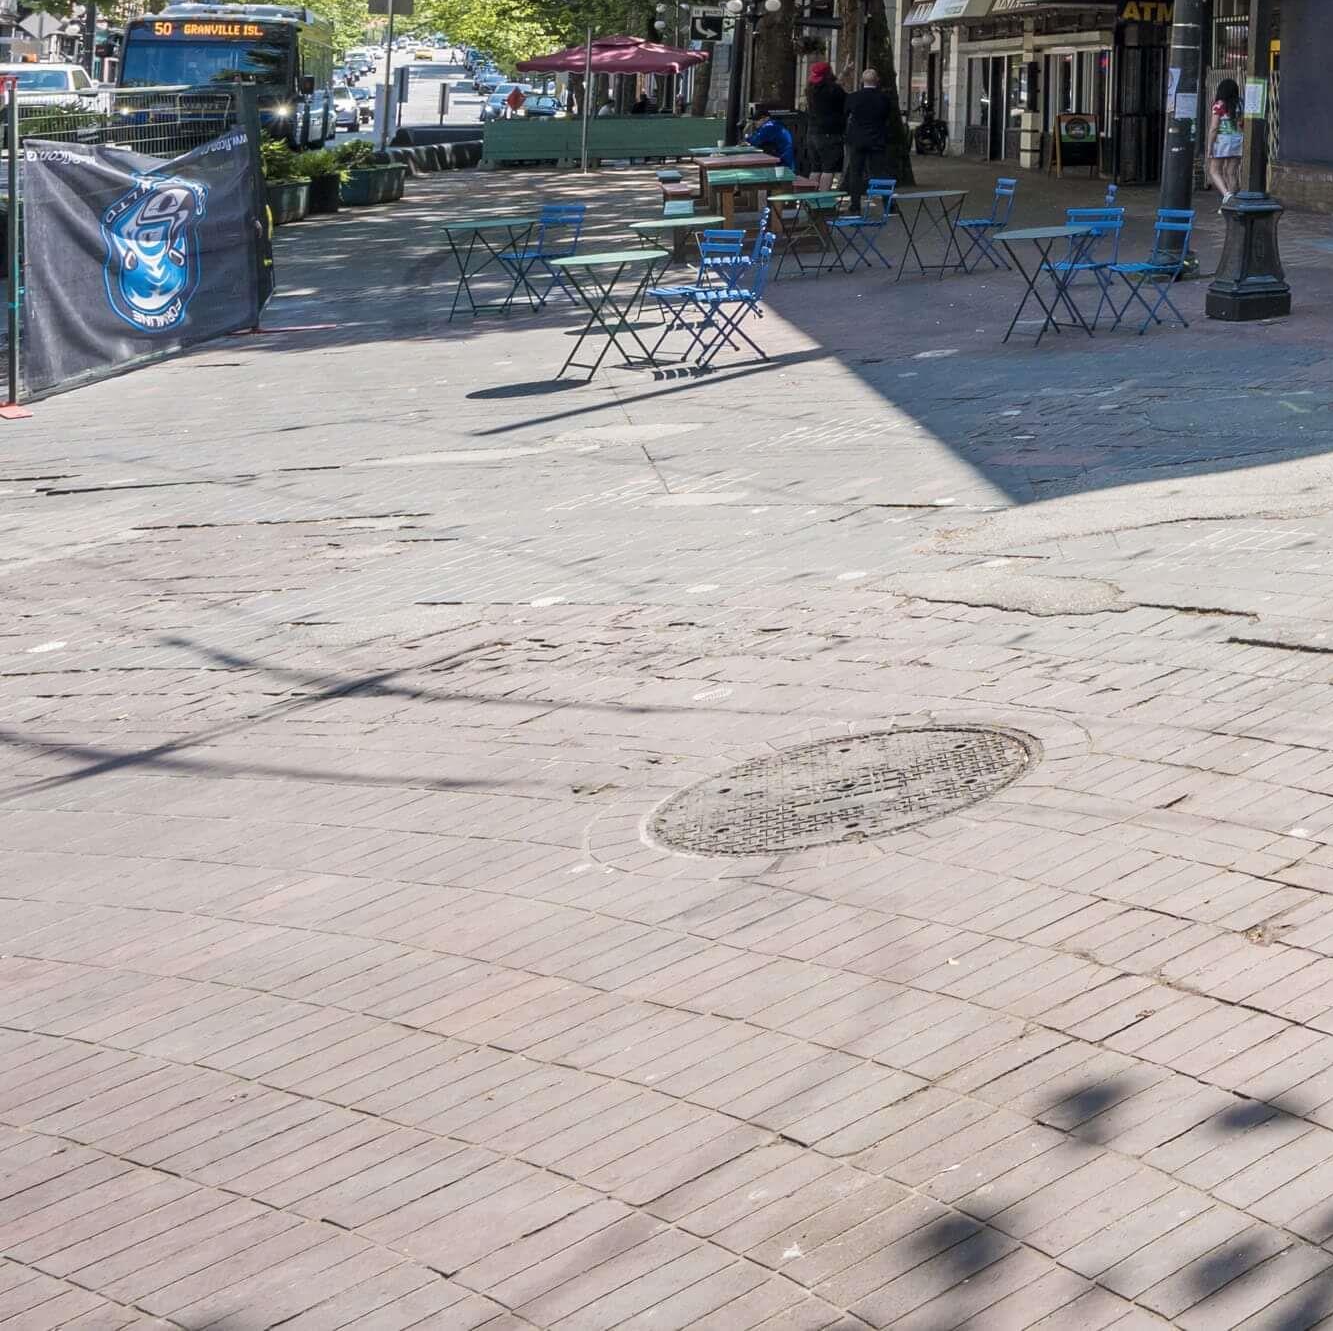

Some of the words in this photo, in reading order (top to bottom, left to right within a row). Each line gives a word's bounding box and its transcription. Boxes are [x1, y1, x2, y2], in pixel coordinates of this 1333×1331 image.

[154, 21, 173, 36] 50
[184, 23, 241, 36] GRANVILLE
[243, 24, 264, 36] ISL.
